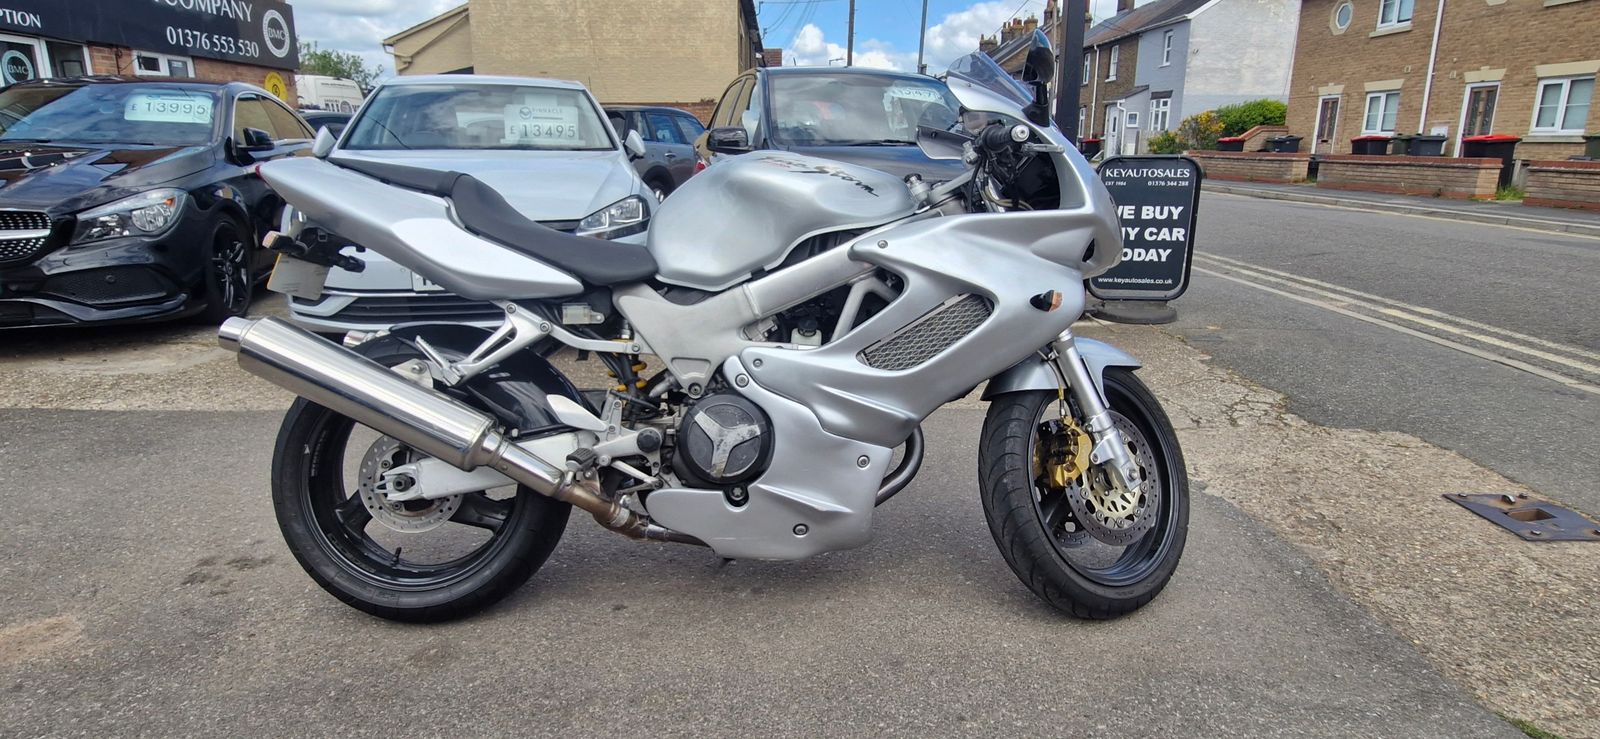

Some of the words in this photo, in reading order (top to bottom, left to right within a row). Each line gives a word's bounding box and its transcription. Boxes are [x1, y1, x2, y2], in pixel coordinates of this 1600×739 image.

[0, 8, 42, 28] TION
[267, 27, 286, 40] BMC
[166, 26, 211, 50] 01376
[212, 35, 236, 54] 553
[238, 39, 260, 58] 530
[7, 64, 29, 75] BMC
[145, 102, 207, 115] 13995
[521, 124, 576, 138] 13495
[1105, 168, 1190, 178] KEYAUTOSALES
[1141, 205, 1184, 220] BUY
[1144, 227, 1186, 242] CAR
[1121, 248, 1172, 262] ODAY
[1098, 276, 1173, 285] www.keyautosales.co.uk
